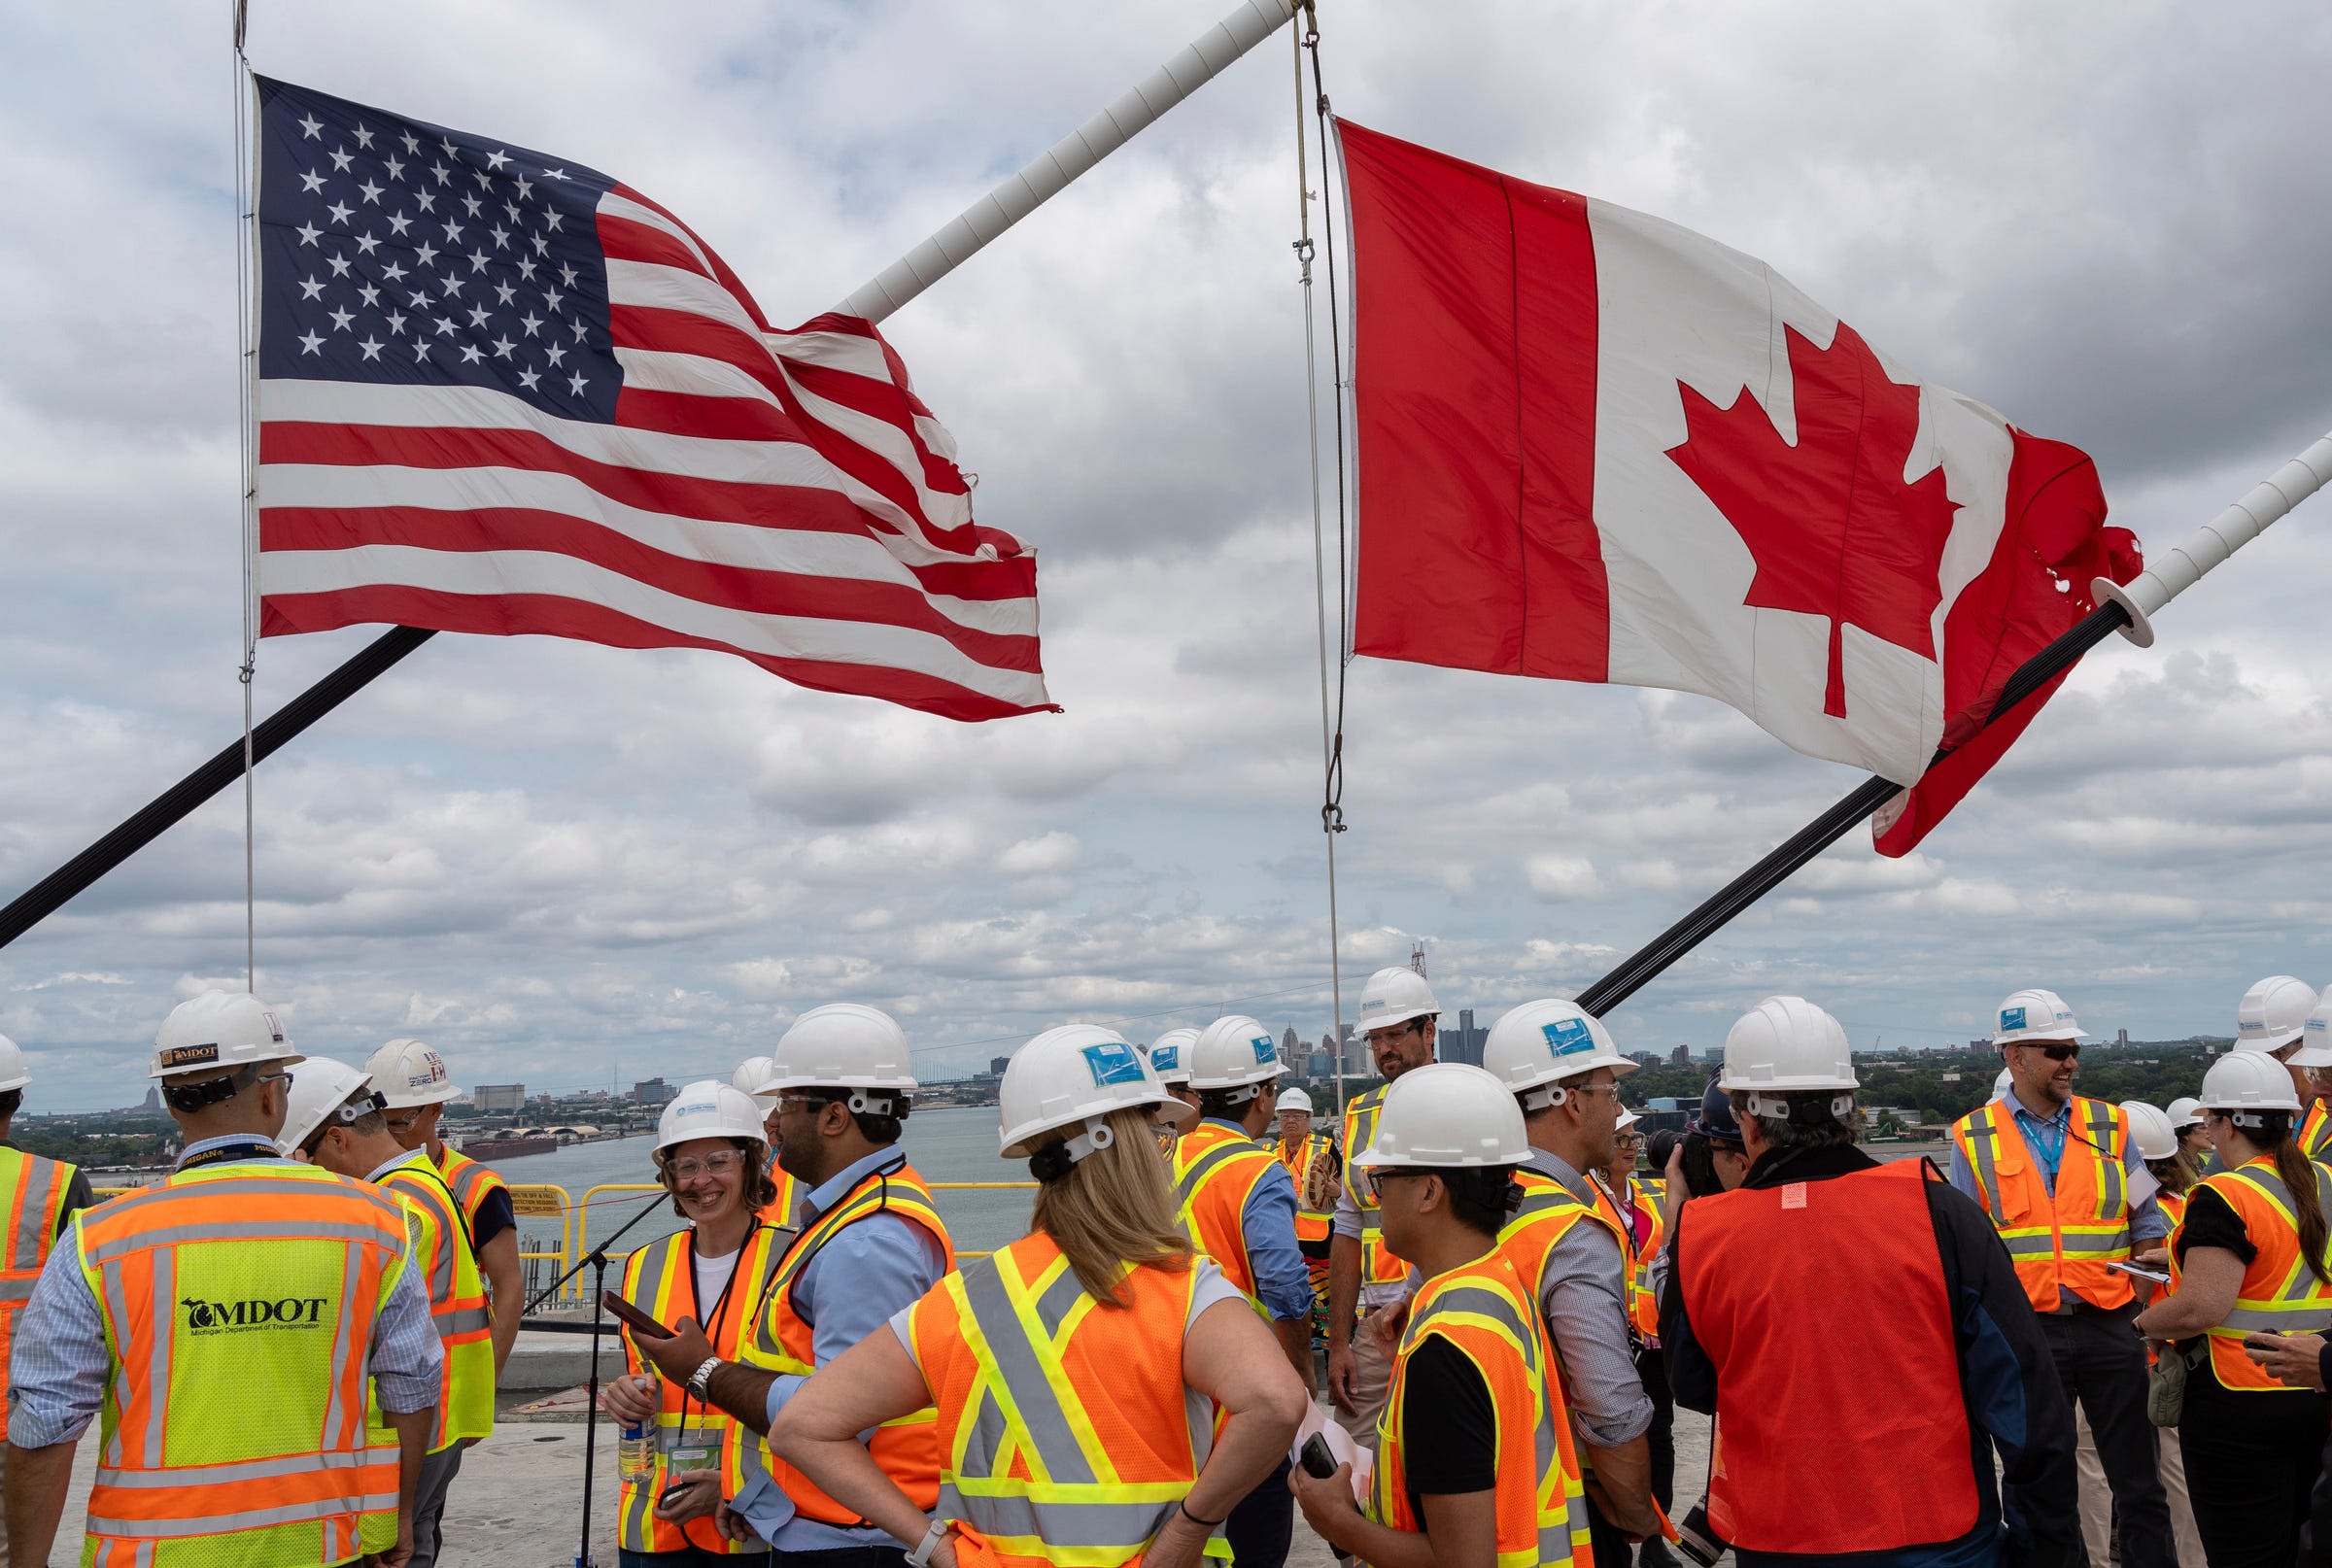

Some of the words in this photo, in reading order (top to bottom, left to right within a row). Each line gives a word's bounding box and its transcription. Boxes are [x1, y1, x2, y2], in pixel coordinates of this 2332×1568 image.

[182, 1047, 217, 1059] MDOT
[409, 1077, 432, 1087] ZERO
[210, 1298, 327, 1327] MDOT
[190, 1328, 223, 1337] Michigan
[225, 1325, 263, 1334] Department
[272, 1322, 320, 1331] Transportation
